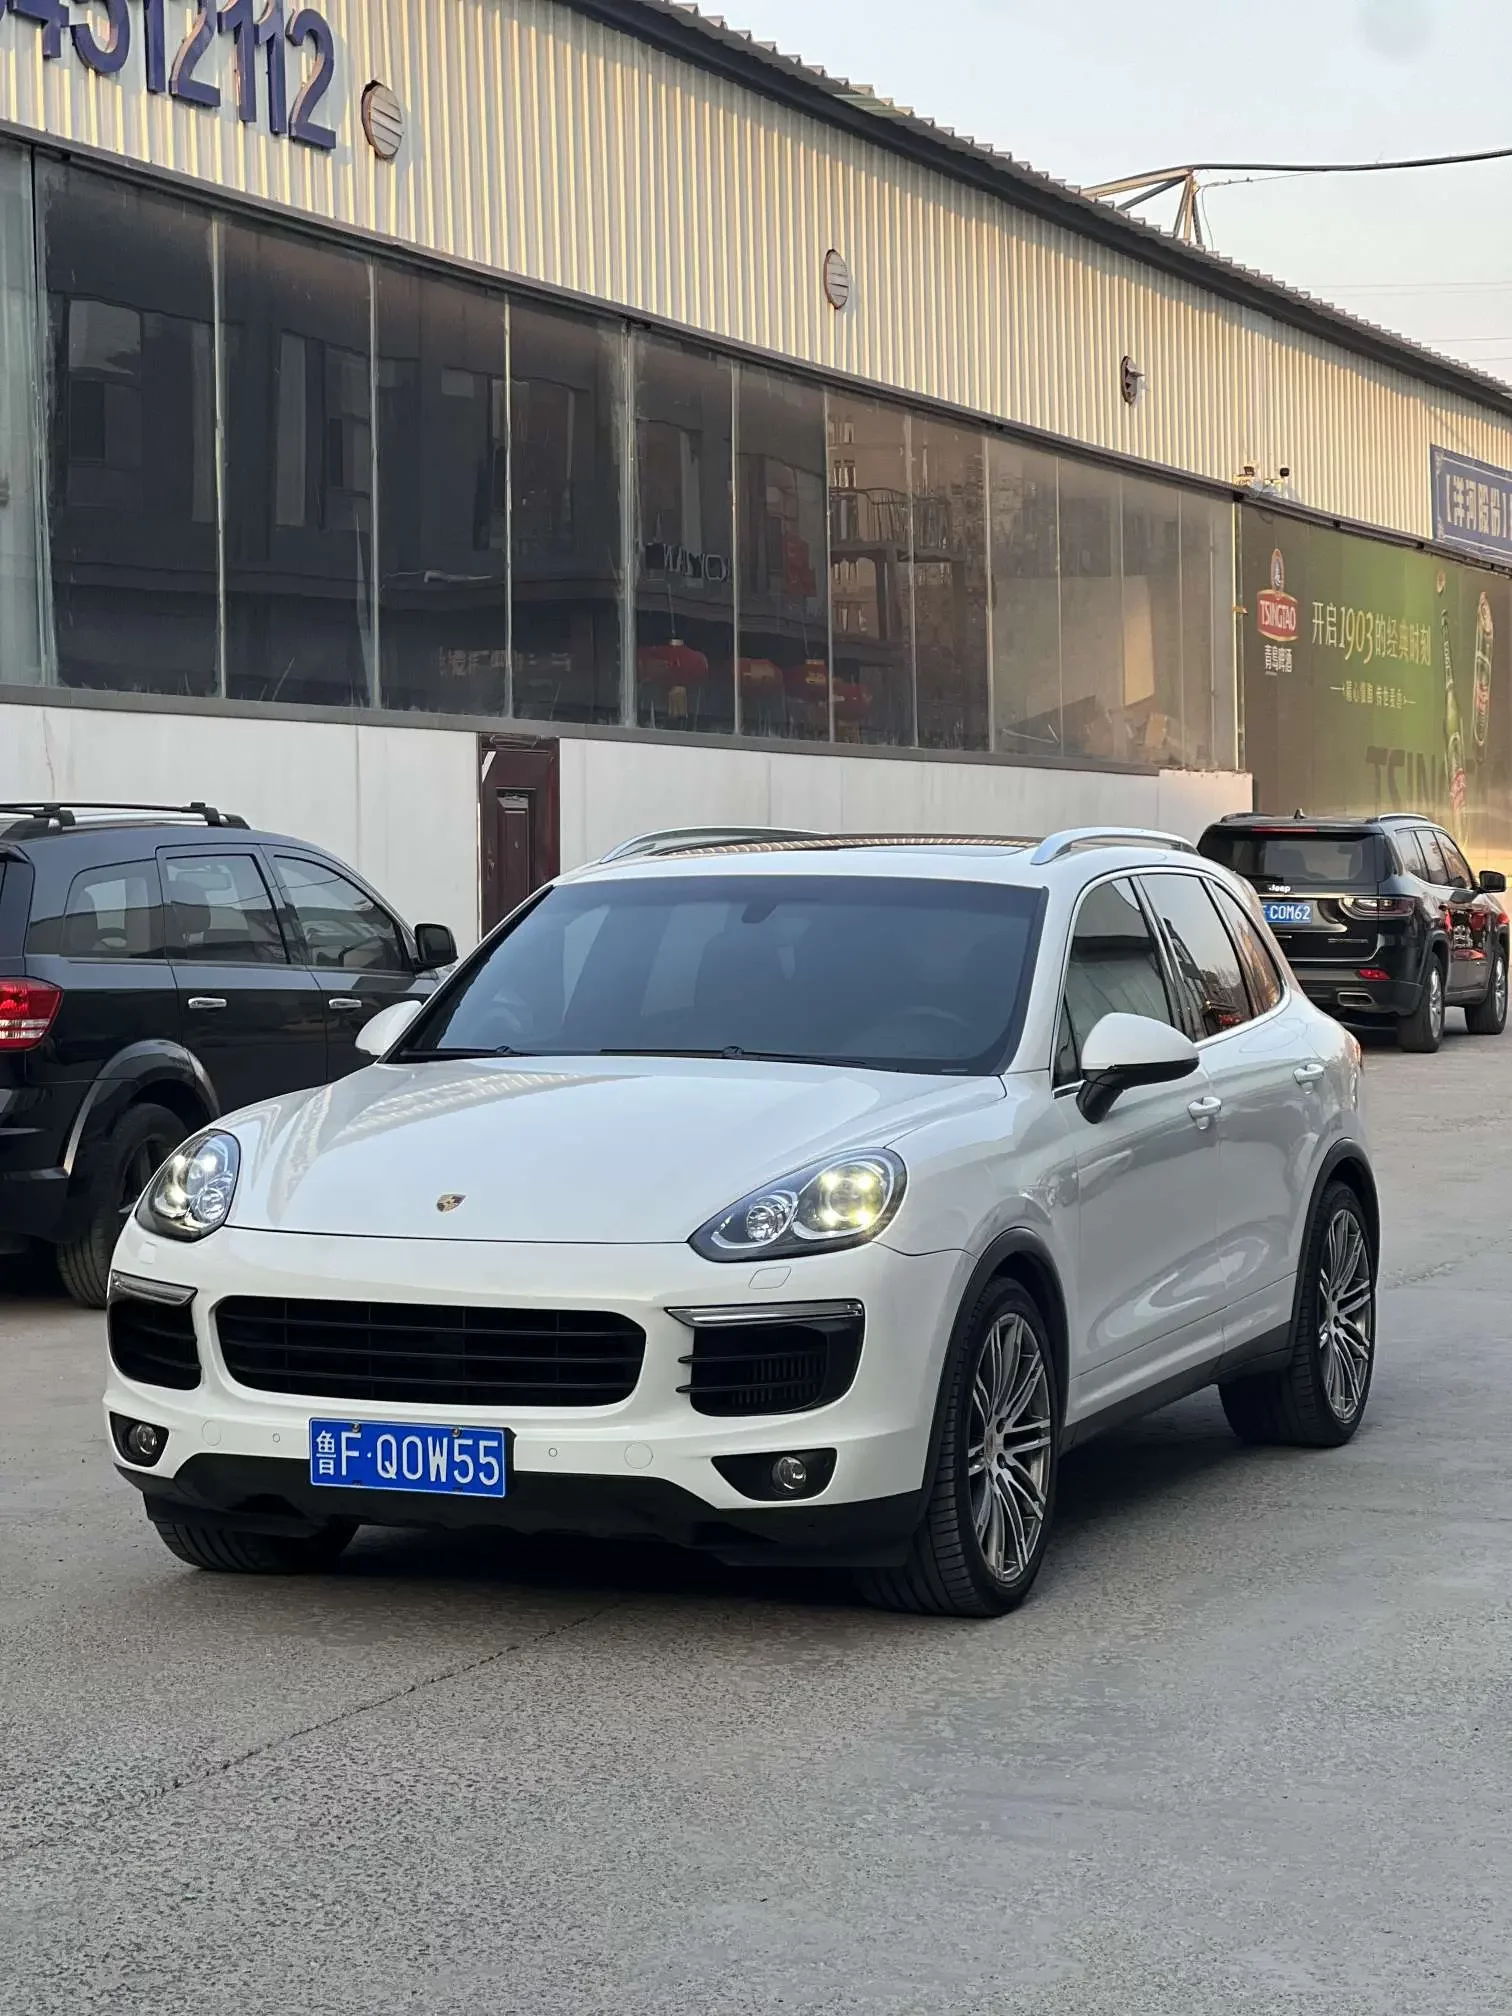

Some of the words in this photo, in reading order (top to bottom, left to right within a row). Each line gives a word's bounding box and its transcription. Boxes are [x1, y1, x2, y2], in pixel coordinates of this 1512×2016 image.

[1259, 600, 1297, 632] TSINGTAO
[1311, 601, 1431, 667] 开启1903的经典时刻
[1268, 884, 1291, 893] Jeep
